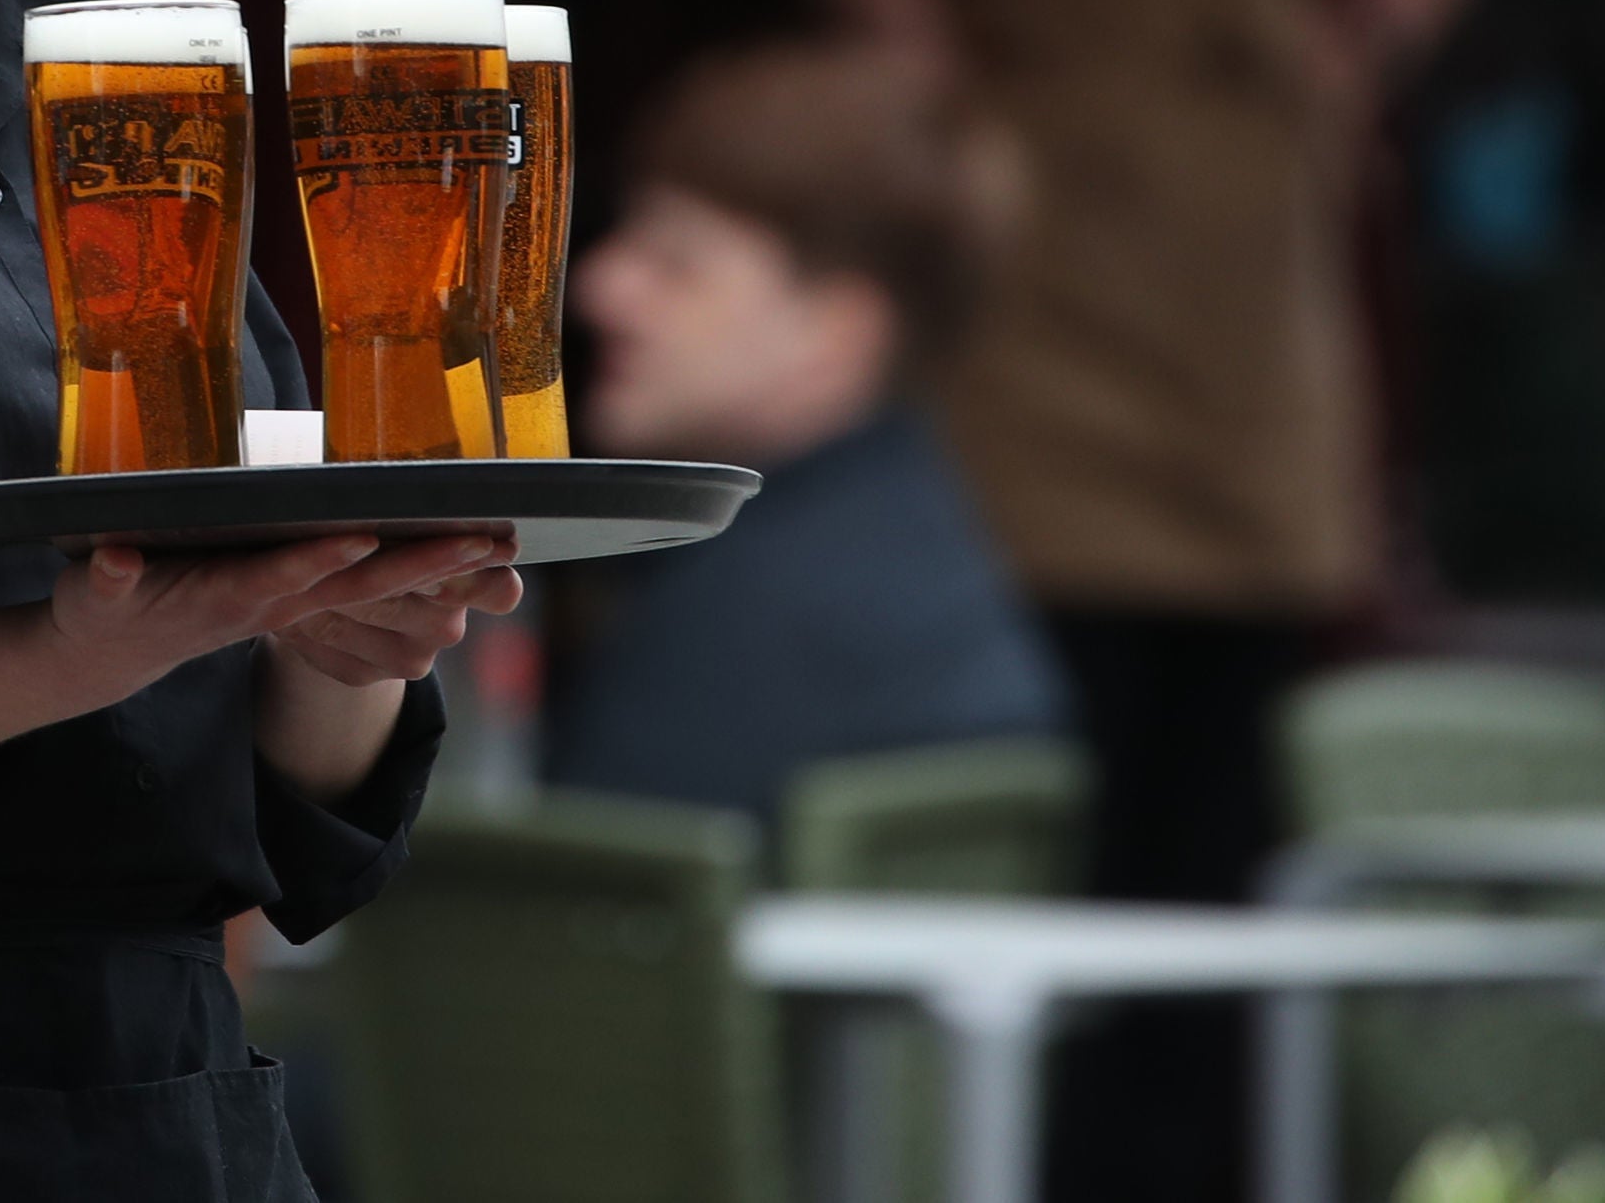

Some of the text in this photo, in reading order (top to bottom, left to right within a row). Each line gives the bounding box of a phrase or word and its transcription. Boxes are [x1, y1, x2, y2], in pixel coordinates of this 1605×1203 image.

[356, 27, 403, 38] ONE PINT
[189, 38, 205, 47] ONE
